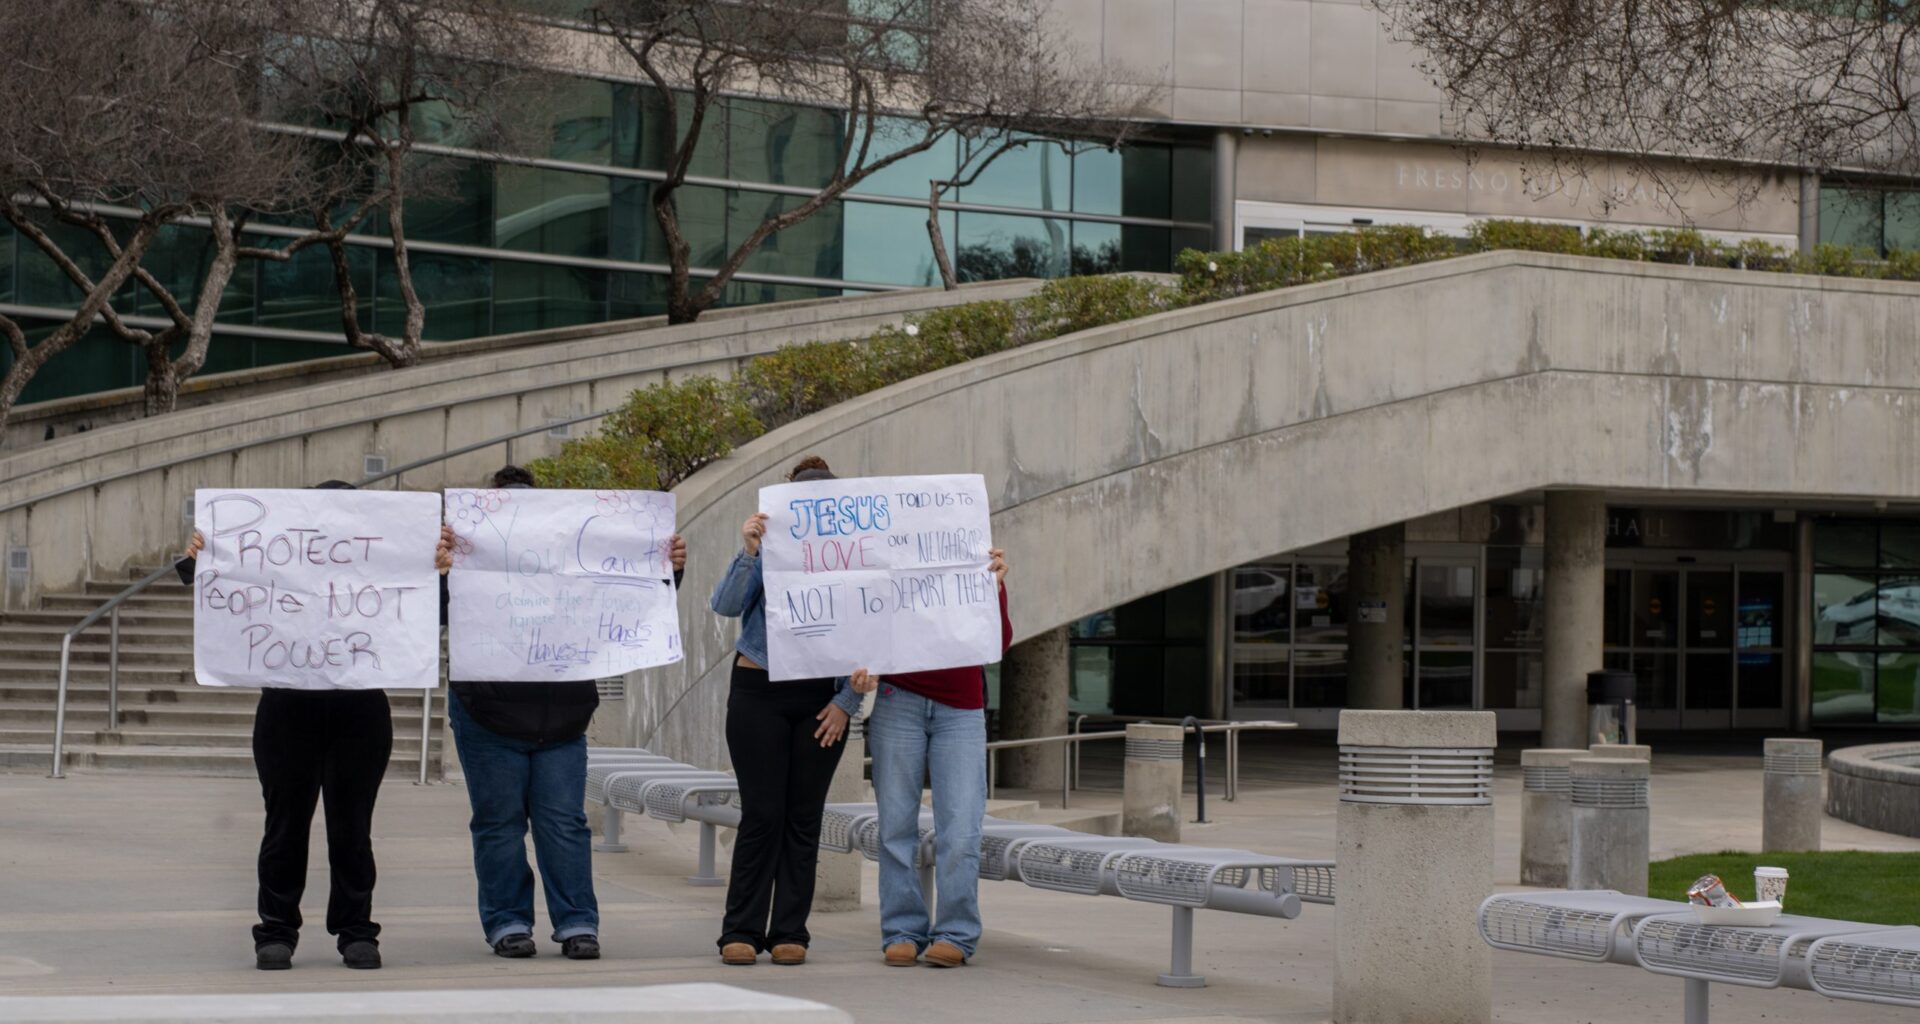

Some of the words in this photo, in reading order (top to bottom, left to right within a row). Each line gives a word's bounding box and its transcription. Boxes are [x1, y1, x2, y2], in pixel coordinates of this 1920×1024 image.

[1398, 165, 1509, 192] FRESNO
[206, 493, 383, 574] PROTECT
[789, 494, 891, 540] JESUS
[895, 492, 932, 510] TOLD
[935, 492, 955, 508] US
[1605, 517, 1670, 538] HALL
[801, 535, 877, 575] LOVE
[328, 580, 417, 620] NOT
[786, 583, 843, 625] NOT
[890, 572, 946, 614] DEPORT
[954, 571, 998, 607] THEM
[598, 611, 652, 642] Hands
[241, 623, 382, 673] POWER
